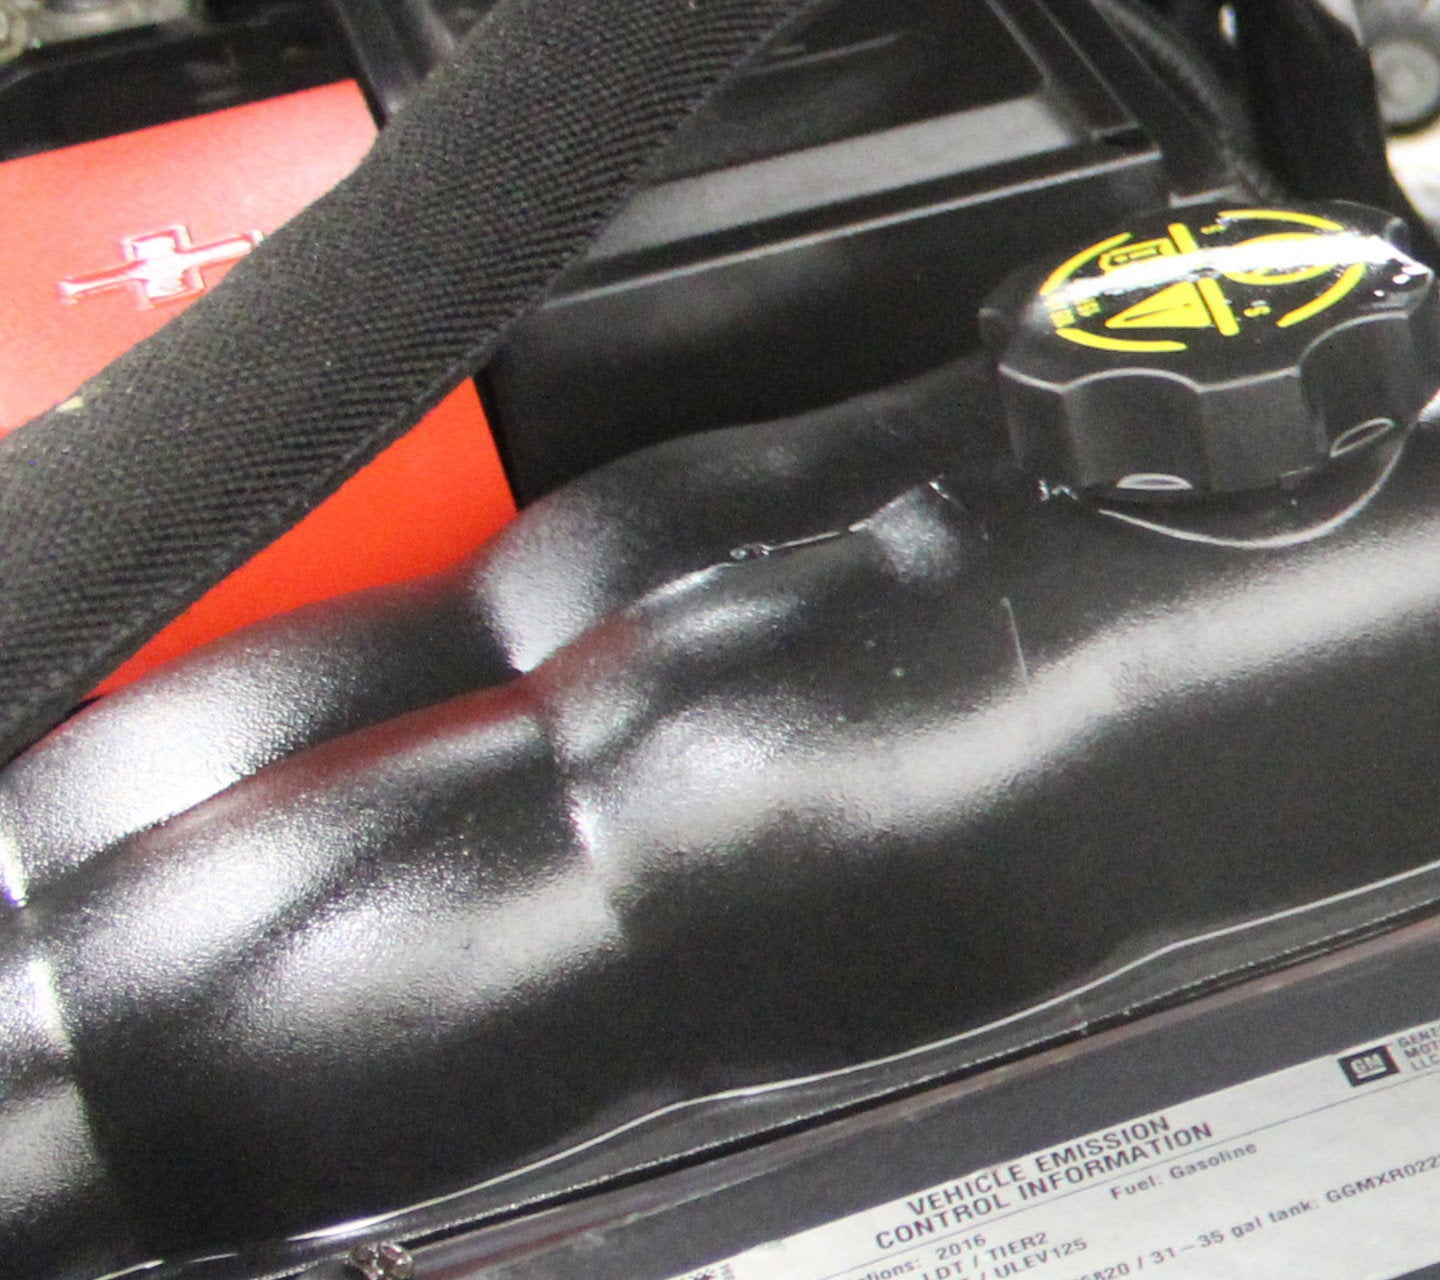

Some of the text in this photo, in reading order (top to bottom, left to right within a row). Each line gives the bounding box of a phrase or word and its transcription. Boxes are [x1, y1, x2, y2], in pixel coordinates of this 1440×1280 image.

[1408, 1054, 1440, 1072] LLC
[876, 1122, 1212, 1249] CONTROL INFORMATION
[906, 1116, 1170, 1216] VEHICLE EMISSION
[1109, 1143, 1257, 1200] Fuel: Gasoline
[1230, 1216, 1263, 1239] gal
[1268, 1200, 1319, 1223] tank:
[935, 1233, 986, 1261] 2016
[986, 1232, 1048, 1261] TIER2
[994, 1237, 1088, 1278] ULEV125
